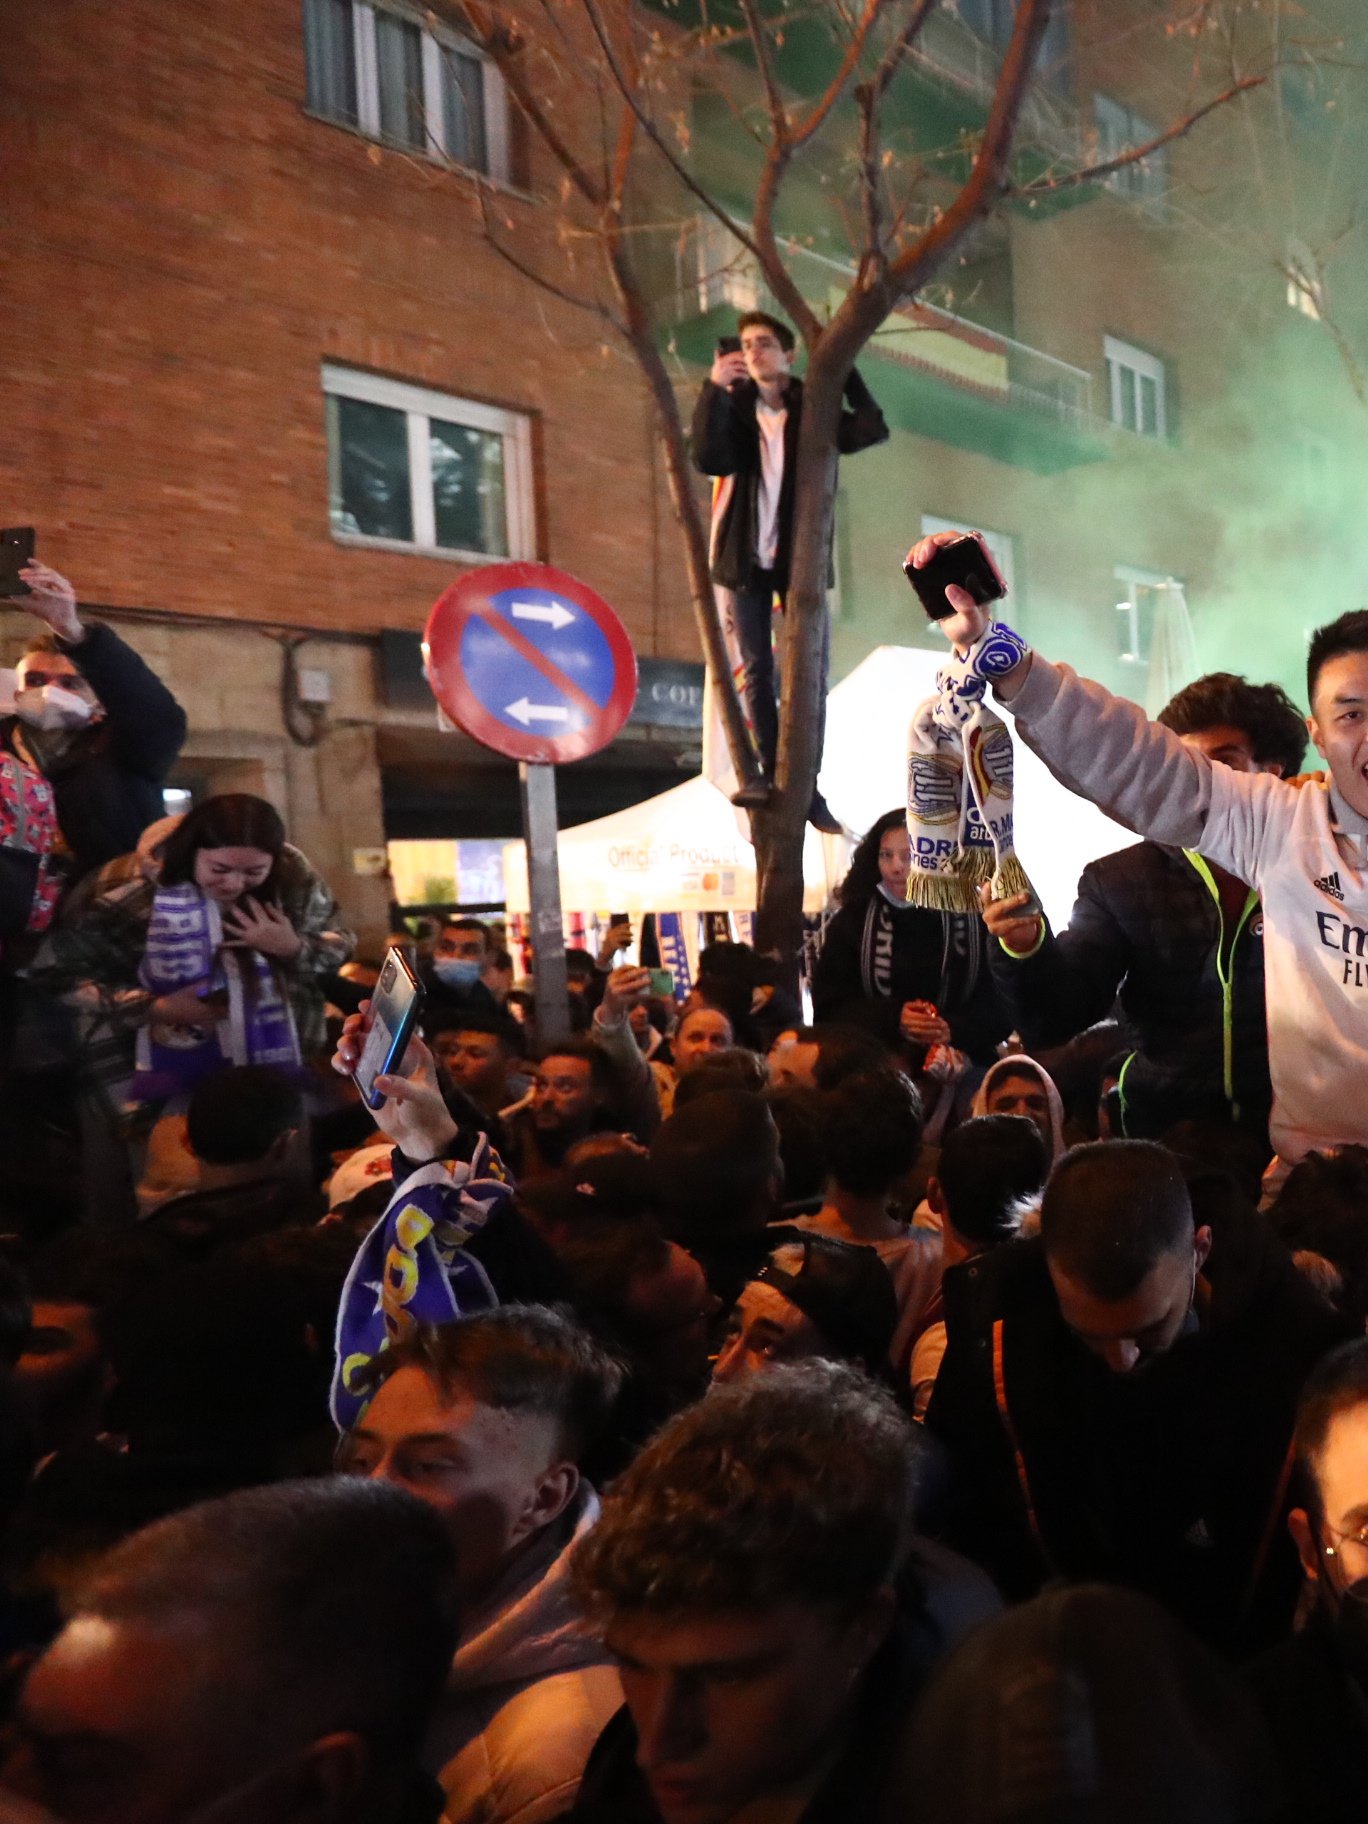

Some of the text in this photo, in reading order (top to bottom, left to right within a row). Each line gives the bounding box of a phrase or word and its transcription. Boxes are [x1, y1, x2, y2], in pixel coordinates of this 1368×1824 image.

[608, 843, 740, 868] Official Product
[1313, 878, 1345, 902] adidas
